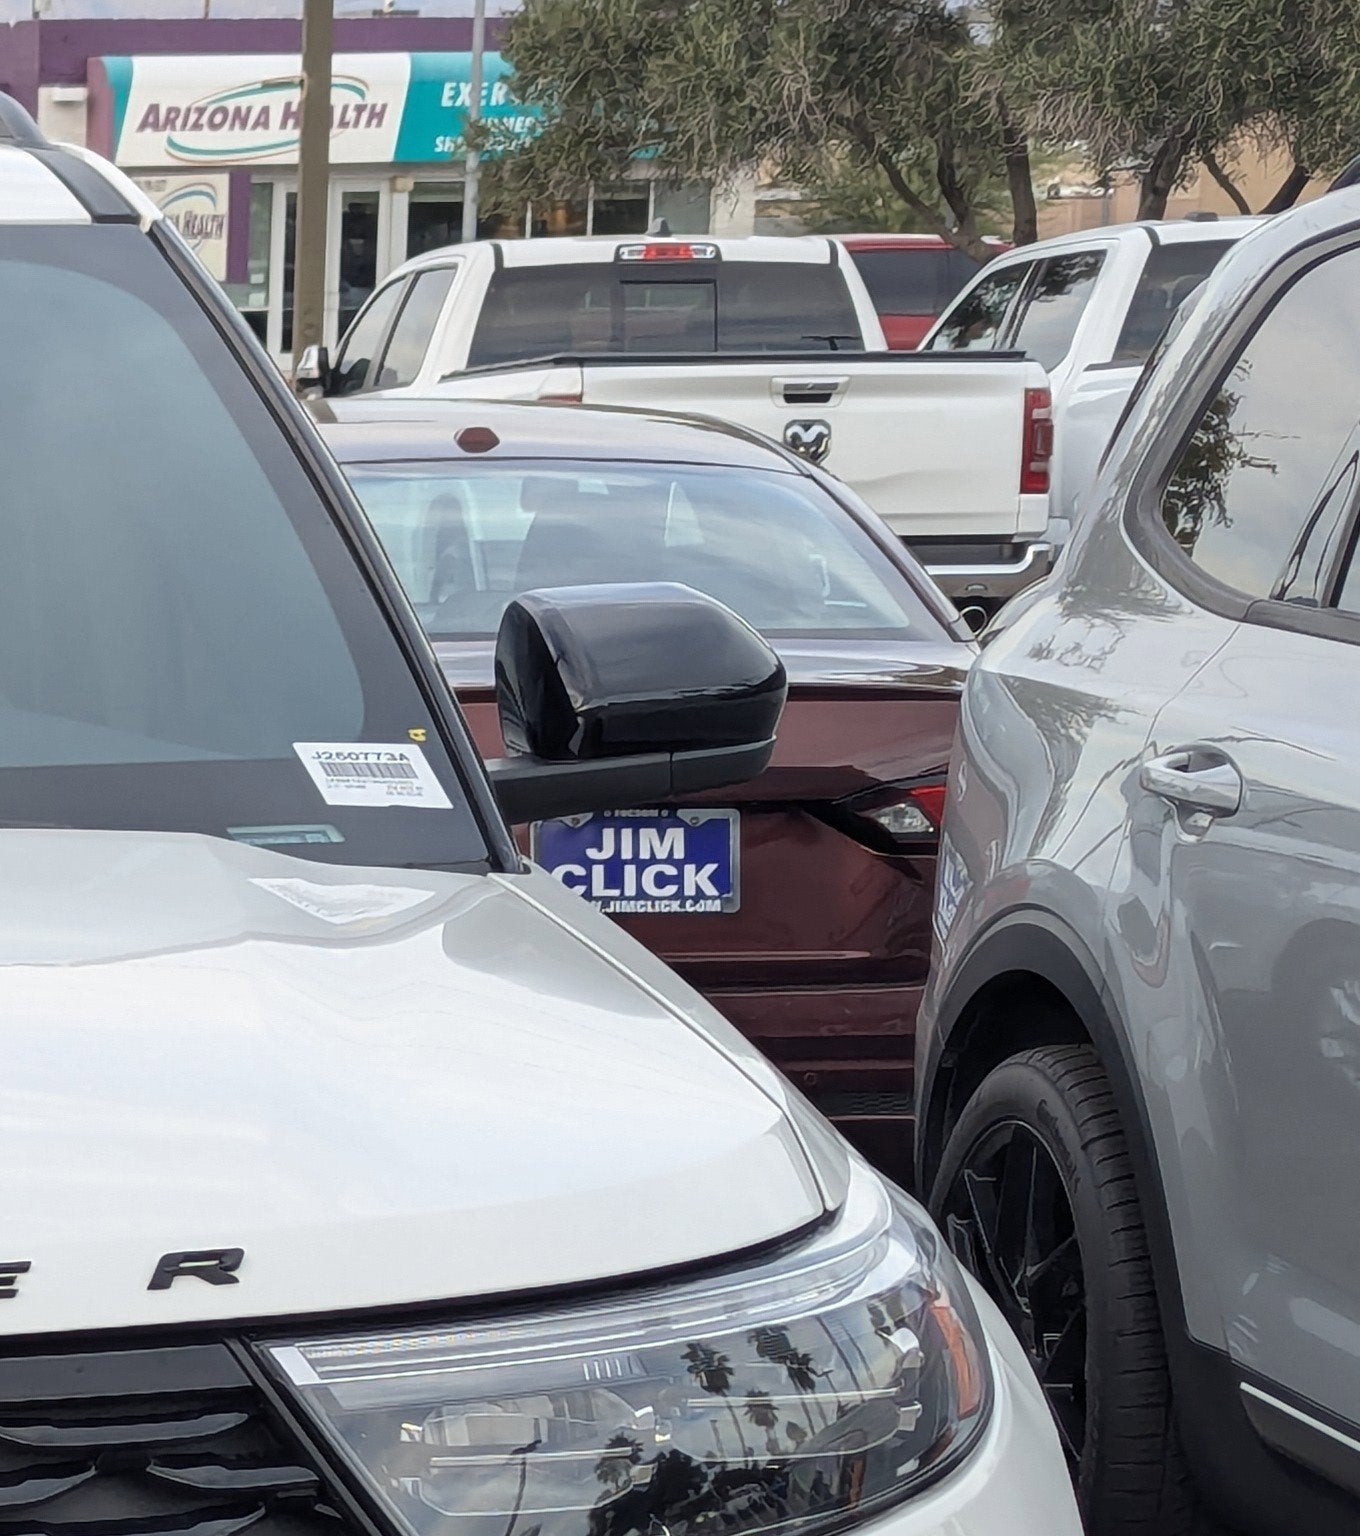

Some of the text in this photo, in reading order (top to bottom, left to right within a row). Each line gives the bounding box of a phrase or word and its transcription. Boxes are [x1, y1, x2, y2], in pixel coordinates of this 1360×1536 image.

[136, 101, 387, 133] ARIZONA HLTH
[585, 827, 685, 859] JIM
[551, 863, 719, 897] CLICK
